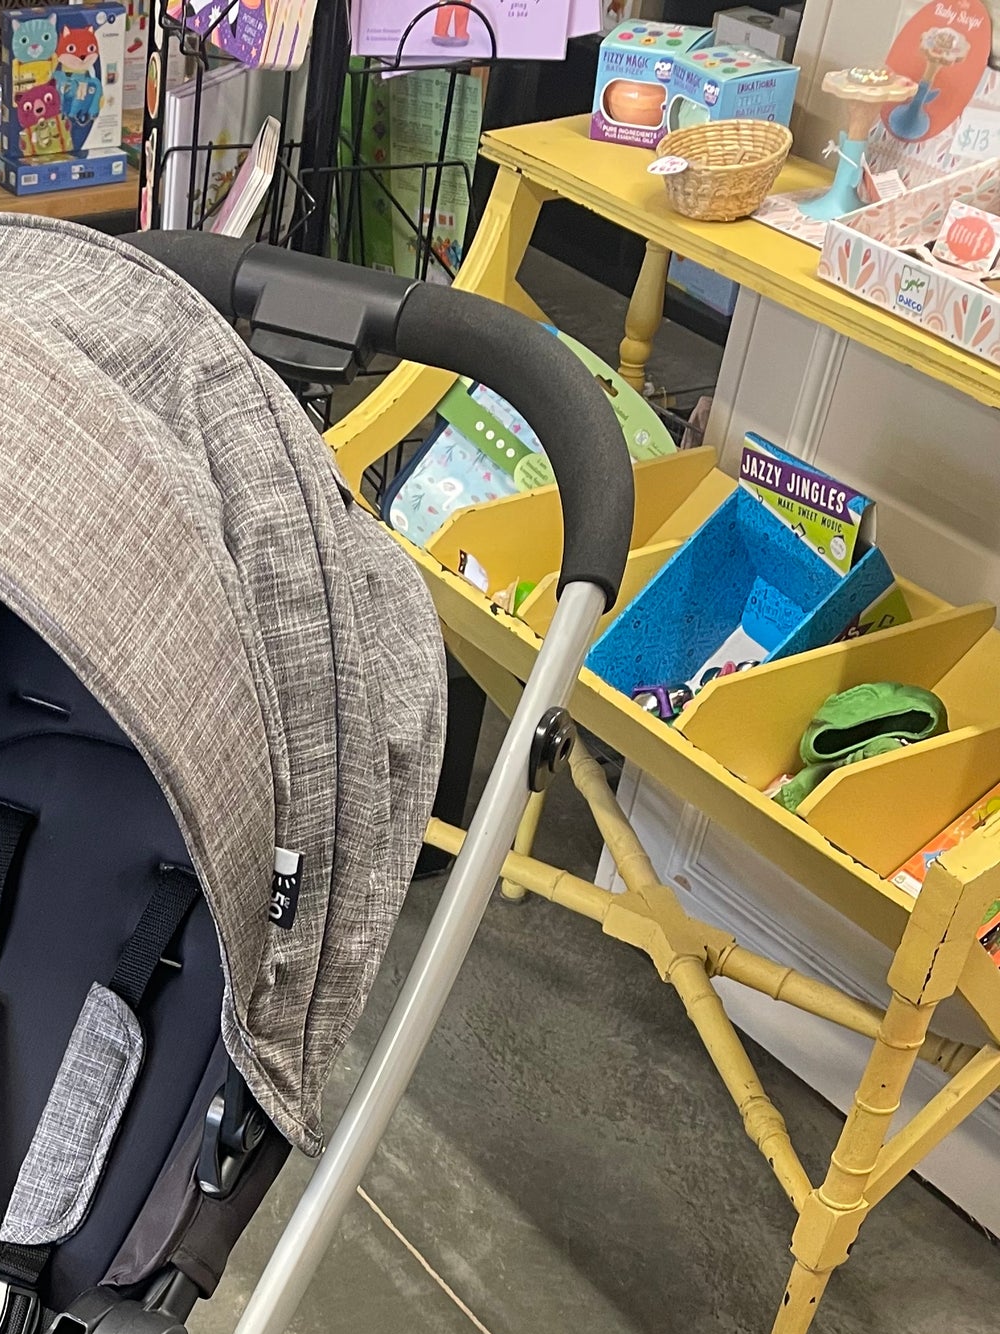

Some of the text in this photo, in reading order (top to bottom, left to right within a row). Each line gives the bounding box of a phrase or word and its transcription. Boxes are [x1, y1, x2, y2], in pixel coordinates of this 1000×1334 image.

[934, 2, 957, 25] Baby
[603, 51, 650, 69] FIZZY MAGIC
[602, 124, 658, 140] PURE INGREDIENTS
[959, 124, 990, 151] $13
[898, 294, 923, 313] DJECO
[742, 454, 846, 514] JAZZY JINGLES
[777, 497, 842, 534] MAKE SWEET MUSIC
